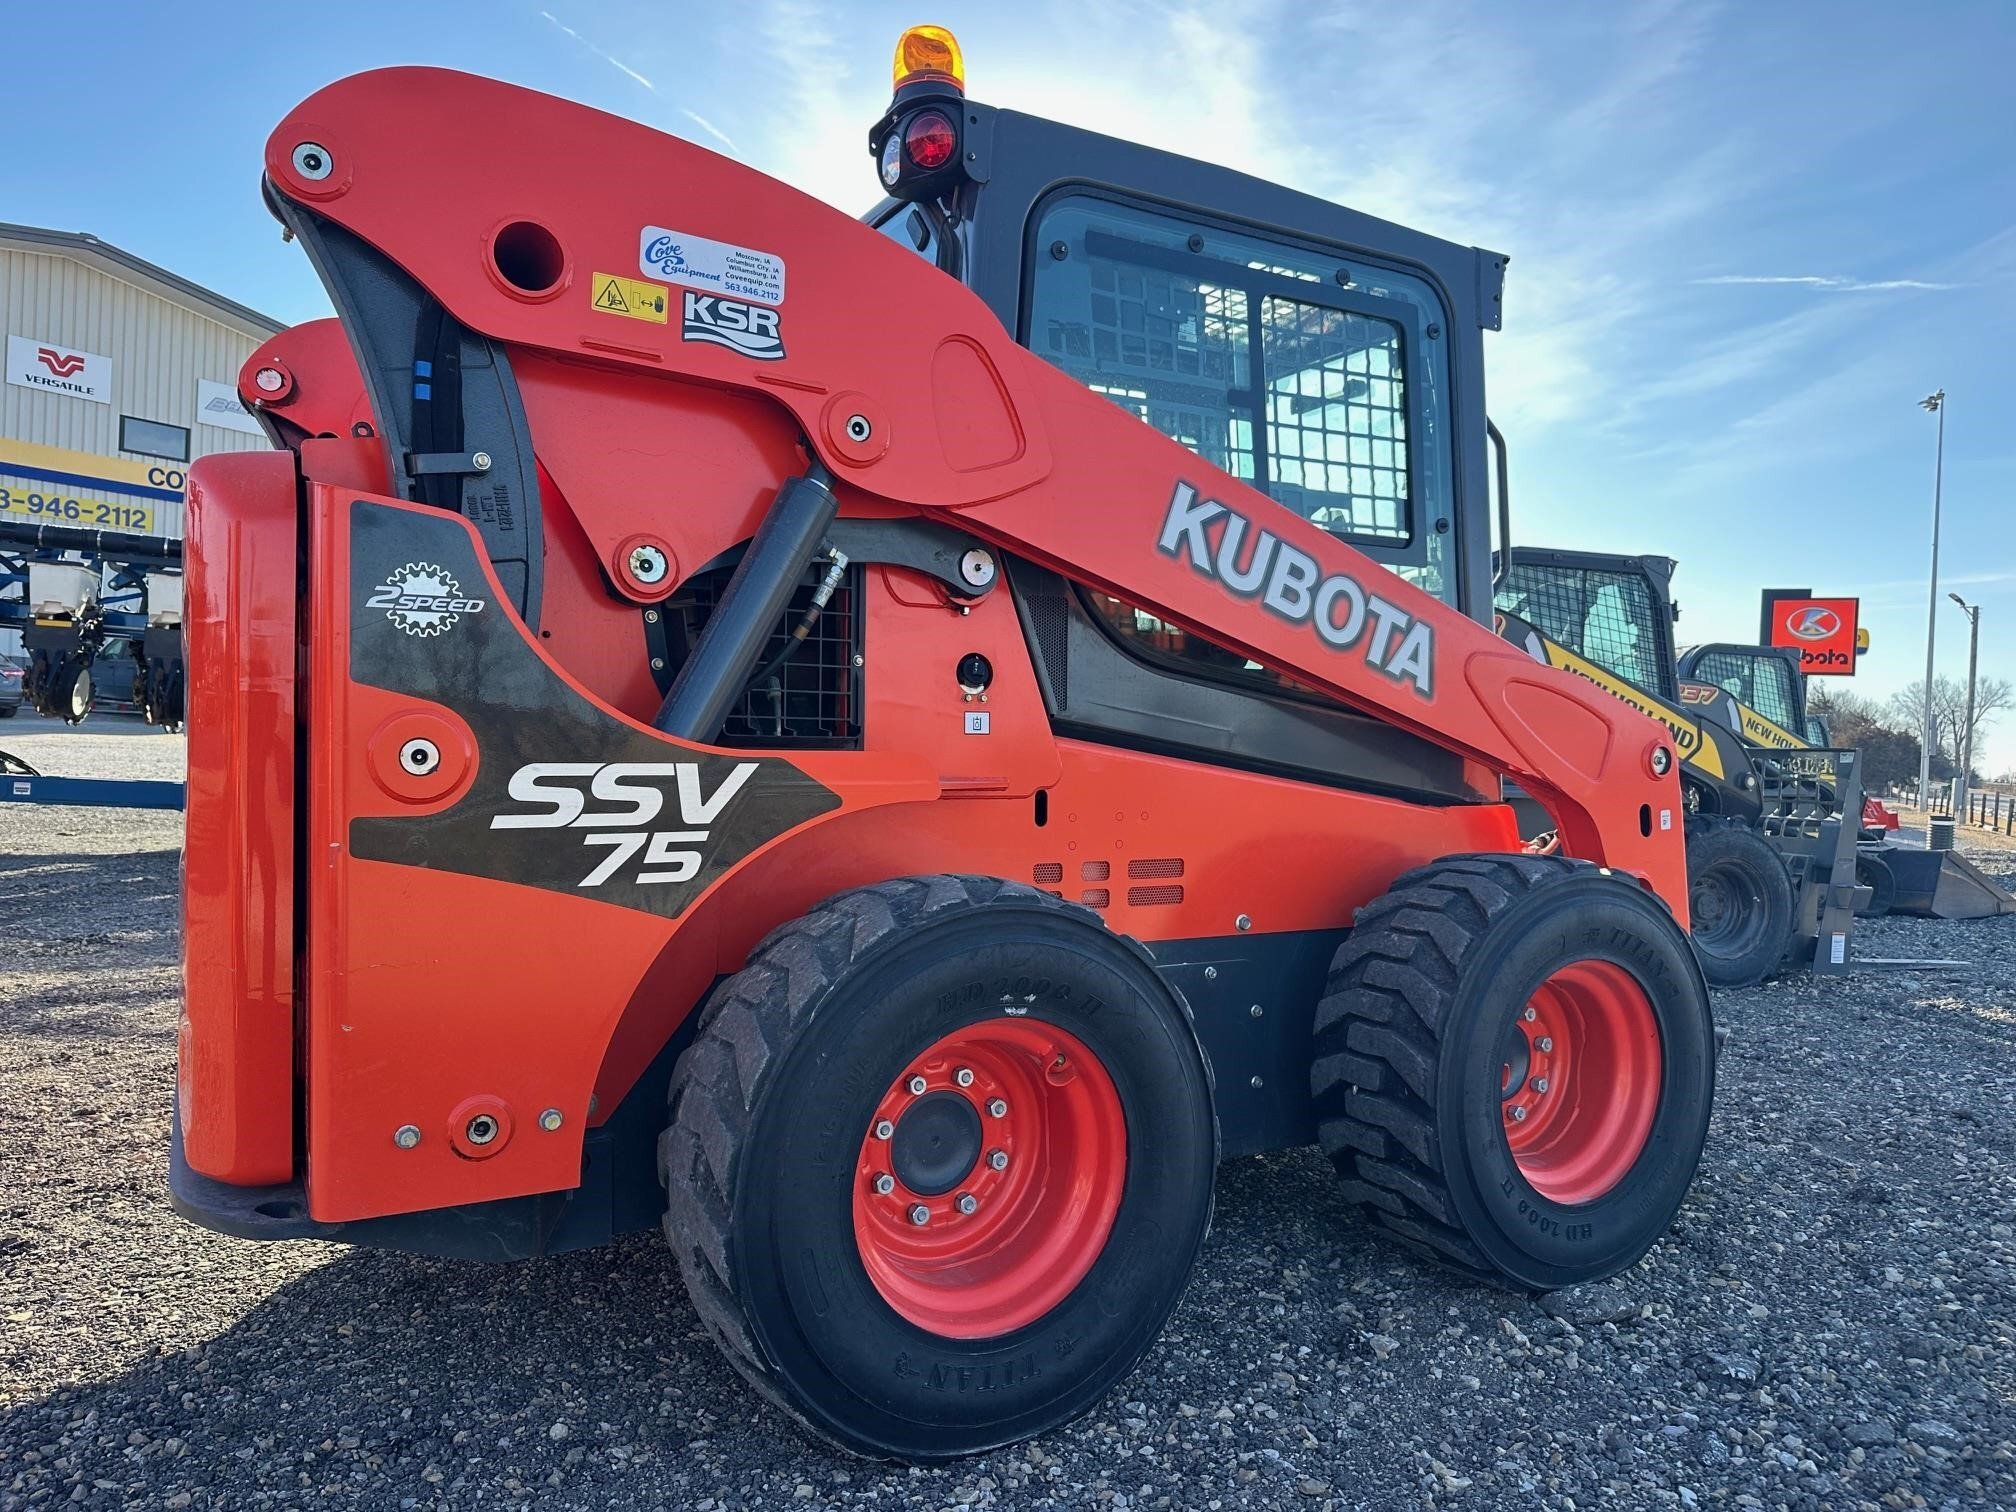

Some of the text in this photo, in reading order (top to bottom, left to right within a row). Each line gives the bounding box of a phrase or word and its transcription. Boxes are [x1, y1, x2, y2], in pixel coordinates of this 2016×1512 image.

[645, 236, 685, 264] Cove
[661, 258, 721, 281] Equipment
[726, 257, 755, 268] Columbus
[725, 272, 780, 290] Coveequip.com
[725, 282, 779, 301] 563.946.2112
[685, 292, 779, 338] KSR
[25, 373, 95, 396] VERSATILE
[148, 467, 187, 489] CO
[1158, 481, 1433, 694] KUBOTA
[1745, 717, 1772, 740] NEW
[489, 762, 760, 829] SSV
[577, 830, 710, 887] 75
